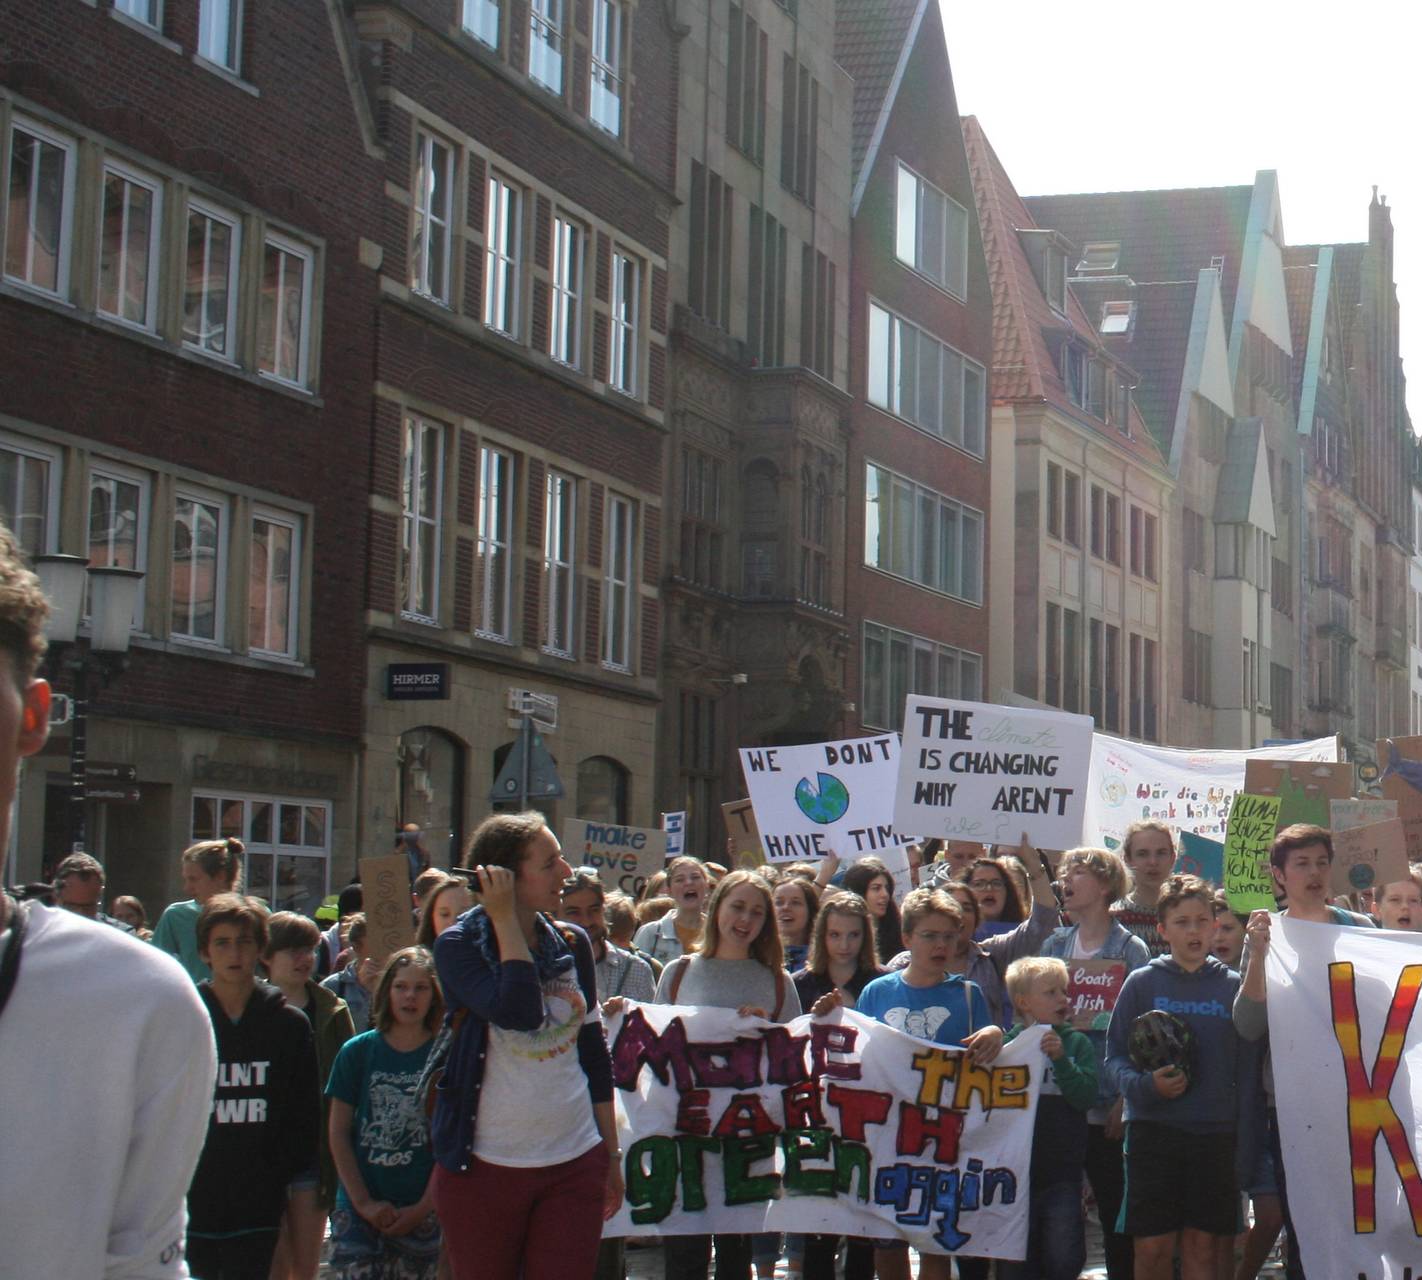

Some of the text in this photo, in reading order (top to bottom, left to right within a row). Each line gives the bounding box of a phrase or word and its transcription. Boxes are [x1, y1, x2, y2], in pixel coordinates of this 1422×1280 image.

[393, 674, 441, 685] HIRMER
[915, 706, 974, 740] THE
[748, 750, 781, 772] WE
[919, 748, 1059, 777] IS CHANGING
[914, 782, 957, 807] WHY
[1177, 786, 1198, 801] die
[765, 833, 828, 858] HAVE
[1073, 994, 1106, 1015] fish
